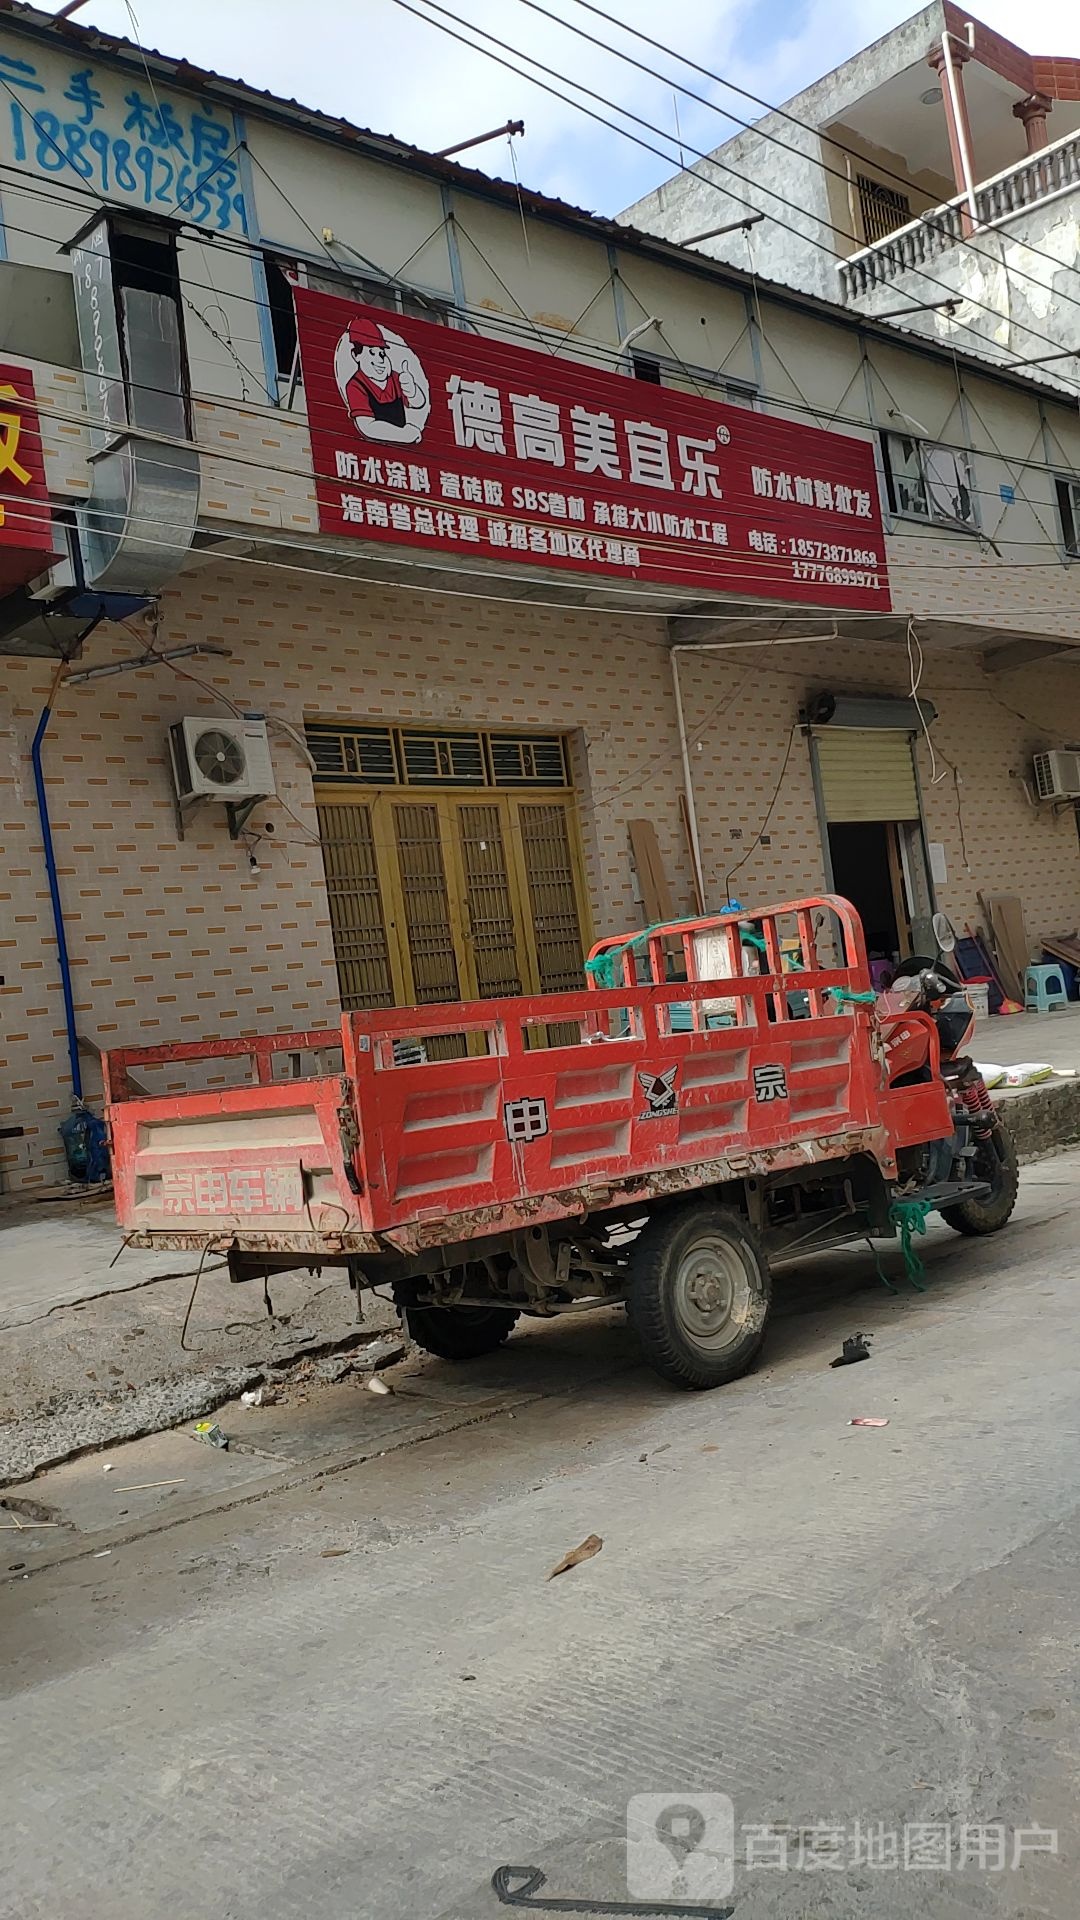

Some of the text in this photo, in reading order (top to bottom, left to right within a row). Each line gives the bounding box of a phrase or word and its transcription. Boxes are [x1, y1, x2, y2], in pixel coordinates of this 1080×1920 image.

[447, 375, 724, 499] 德高美宜乐
[334, 449, 730, 547] 防水涂料 瓷砖胶 SBS卷材 承接大小防水工程
[750, 465, 874, 520] 防水材料批发
[339, 493, 641, 568] 海南省总代理 诚招各地区代理商
[753, 1064, 789, 1104] 宗
[503, 1097, 549, 1144] 申
[161, 1166, 304, 1214] 宗申车辆
